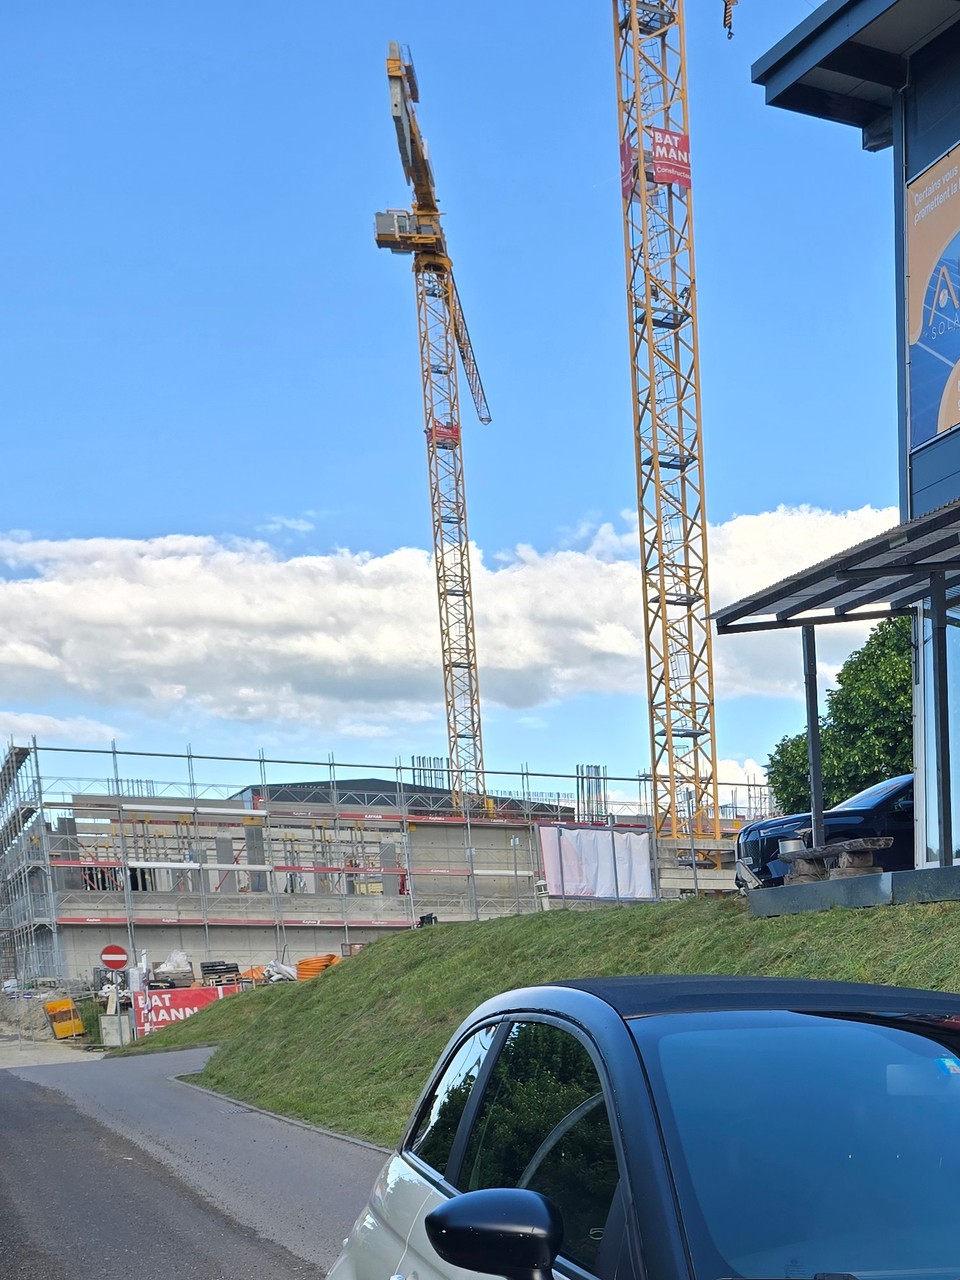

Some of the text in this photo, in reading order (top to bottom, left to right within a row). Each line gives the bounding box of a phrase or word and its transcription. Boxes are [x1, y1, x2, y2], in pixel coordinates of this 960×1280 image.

[655, 131, 680, 148] BAT
[655, 146, 690, 164] MAN
[913, 165, 959, 206] Certains vous
[914, 189, 951, 226] promettent
[950, 183, 958, 195] la
